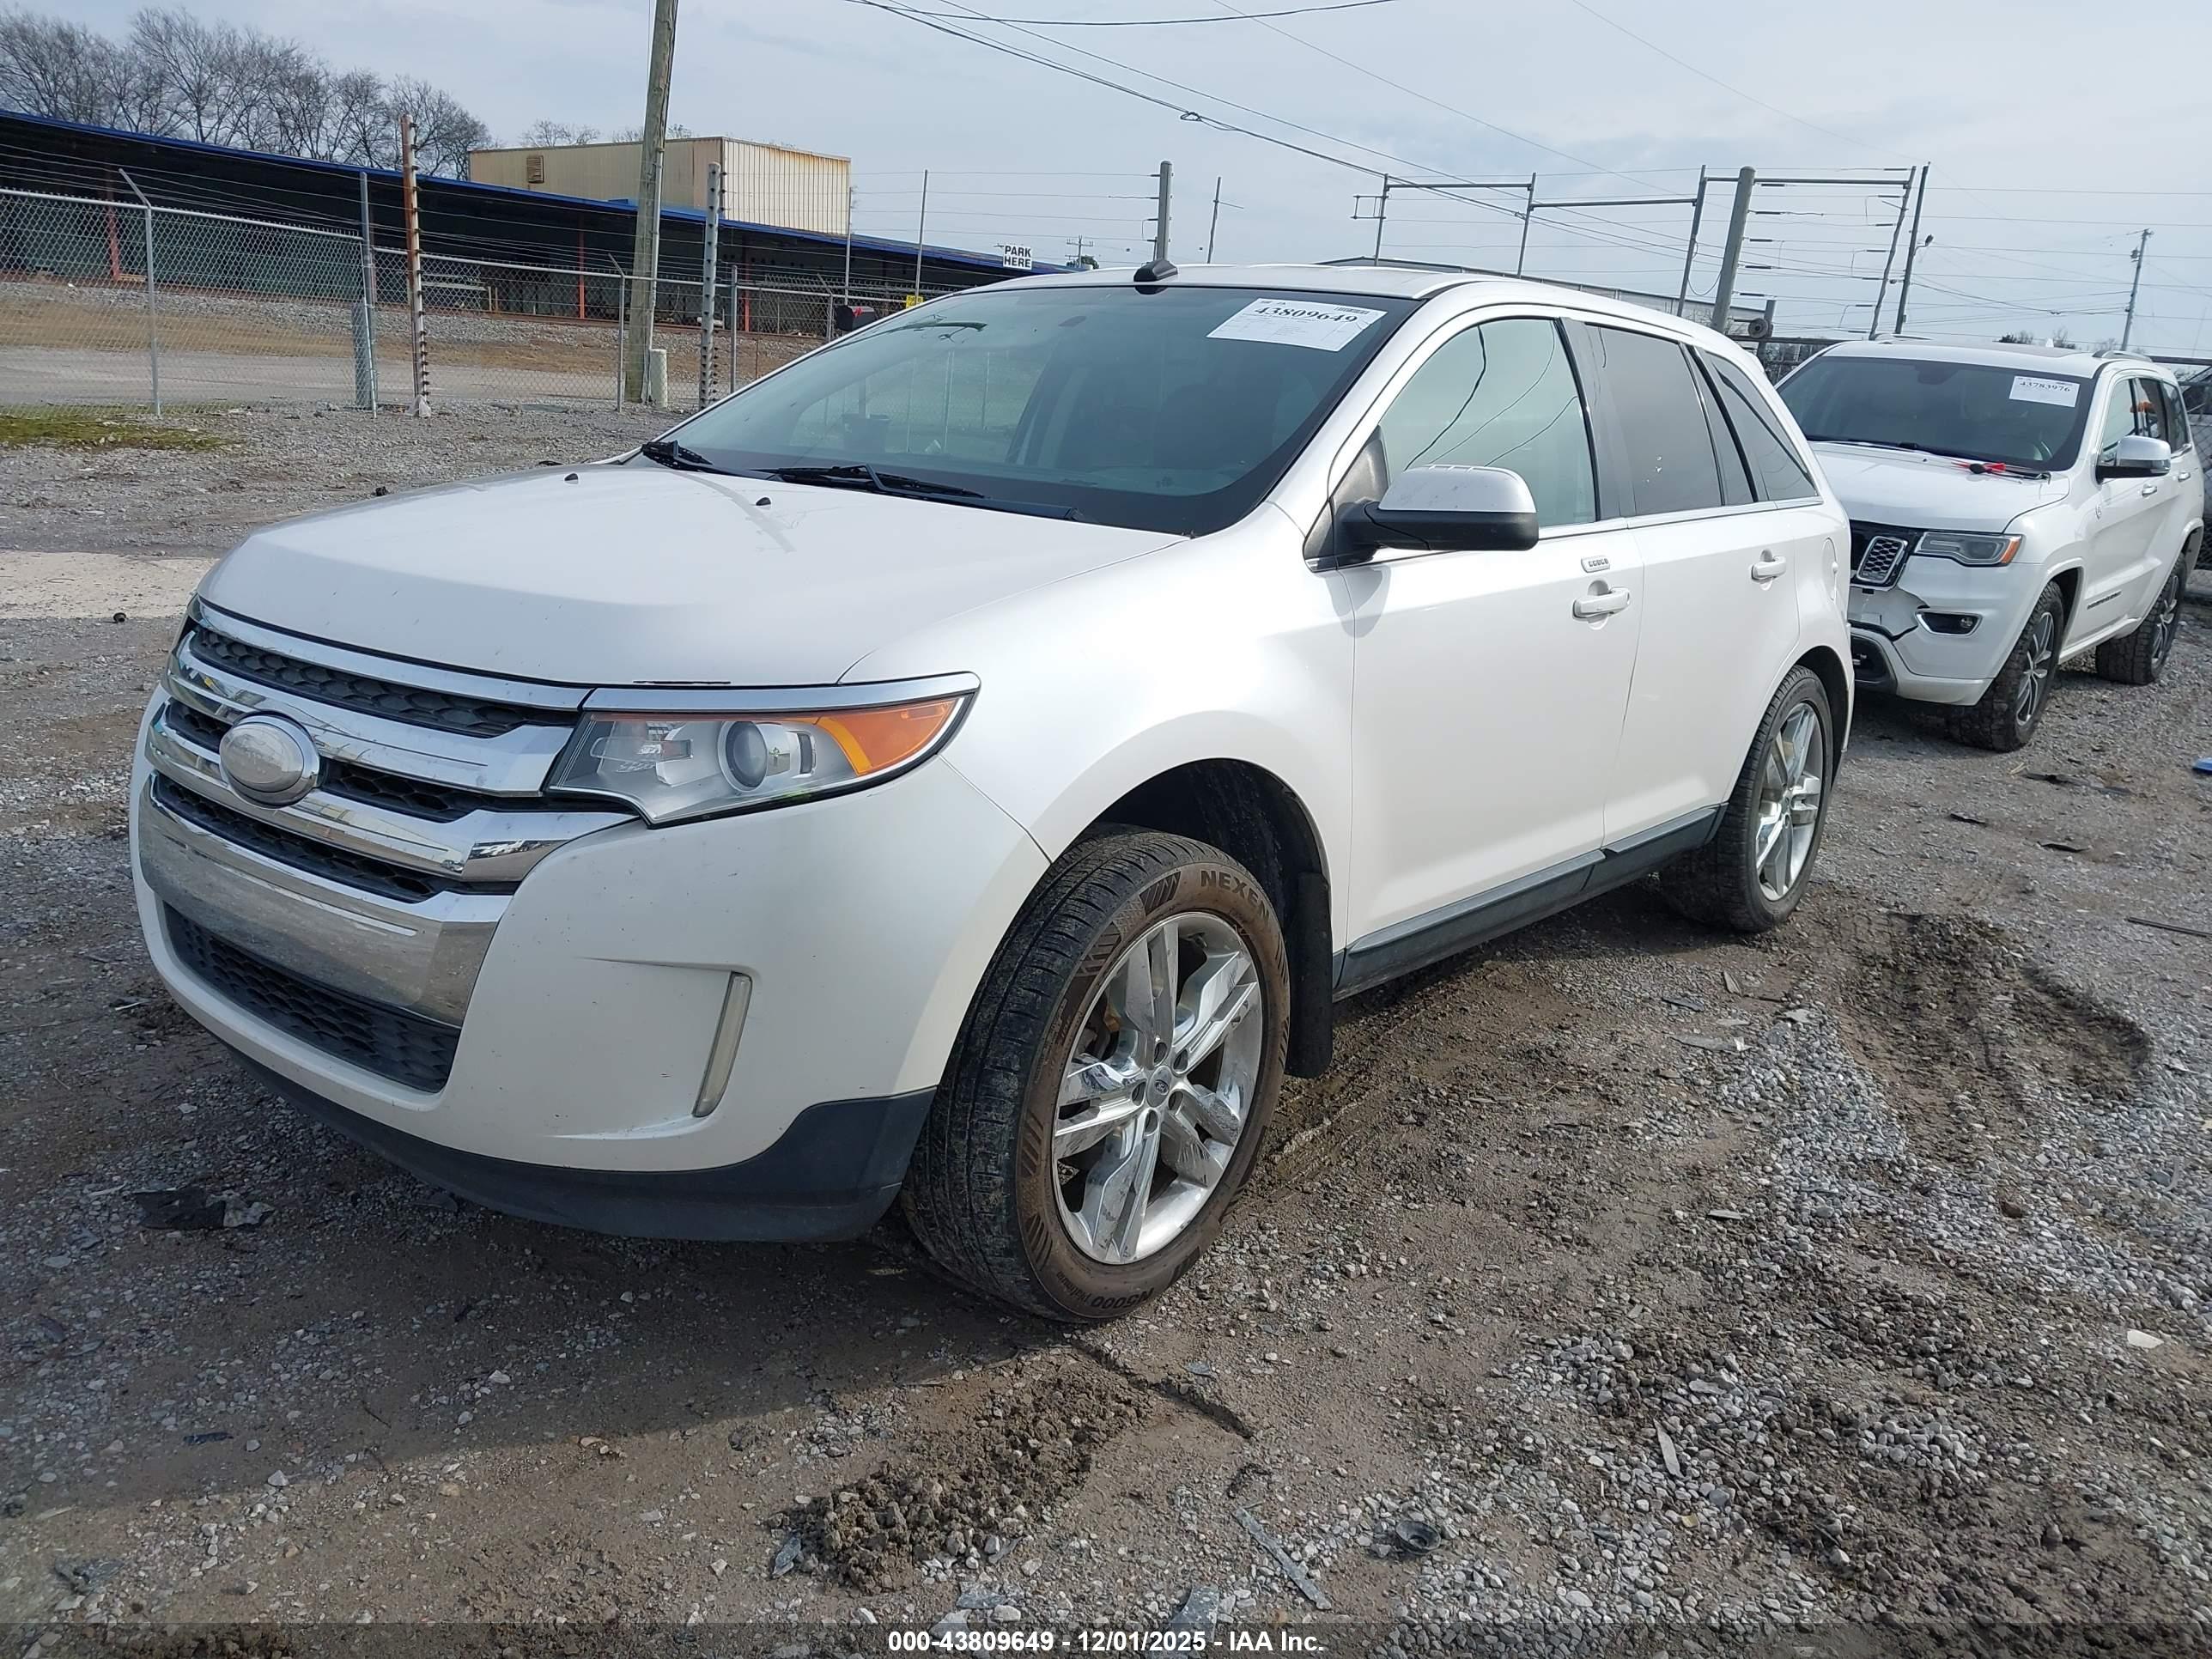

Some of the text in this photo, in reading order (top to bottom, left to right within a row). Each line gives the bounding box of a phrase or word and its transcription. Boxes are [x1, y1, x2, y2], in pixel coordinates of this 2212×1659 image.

[1005, 245, 1031, 258] PARK
[1004, 256, 1031, 268] HERE
[1255, 307, 1358, 323] 43809649
[1200, 870, 1270, 921] NEXEN
